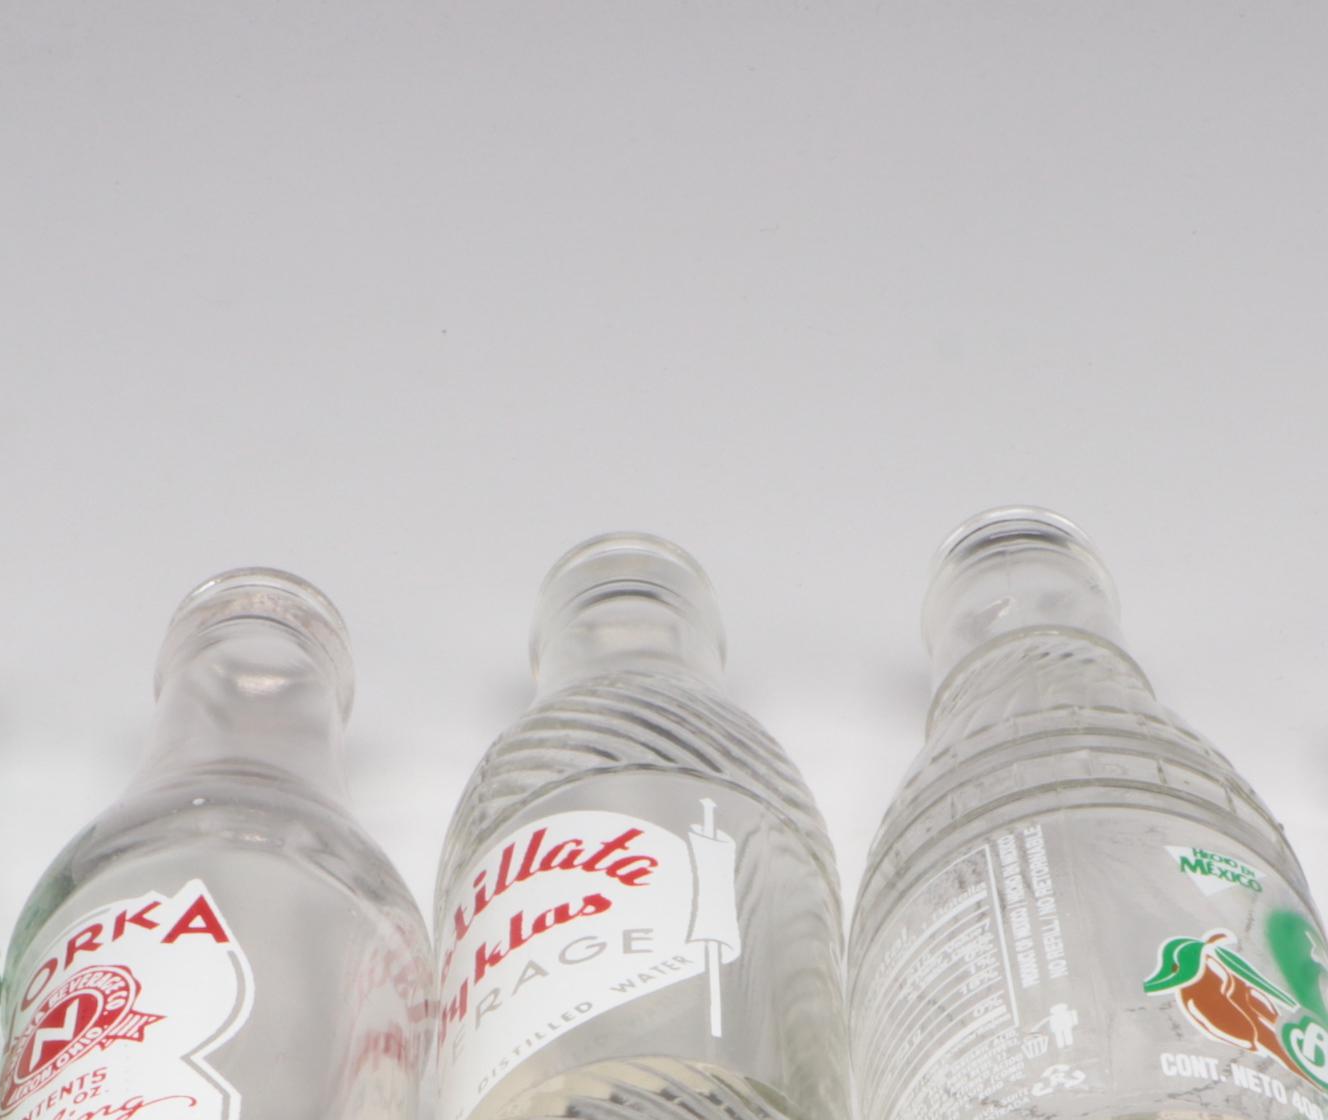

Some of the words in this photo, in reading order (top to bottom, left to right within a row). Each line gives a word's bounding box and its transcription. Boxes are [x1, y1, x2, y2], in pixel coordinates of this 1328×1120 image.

[451, 827, 660, 943] tillata
[1035, 896, 1056, 915] NO
[14, 893, 230, 1020] ORKA
[1040, 920, 1064, 960] REFILL
[1048, 958, 1069, 979] NO
[452, 928, 655, 1062] ERAGE
[477, 1001, 594, 1095] DISTILLED
[610, 954, 695, 994] WATER
[1160, 1052, 1227, 1082] CONT.
[1230, 1062, 1288, 1105] NETO
